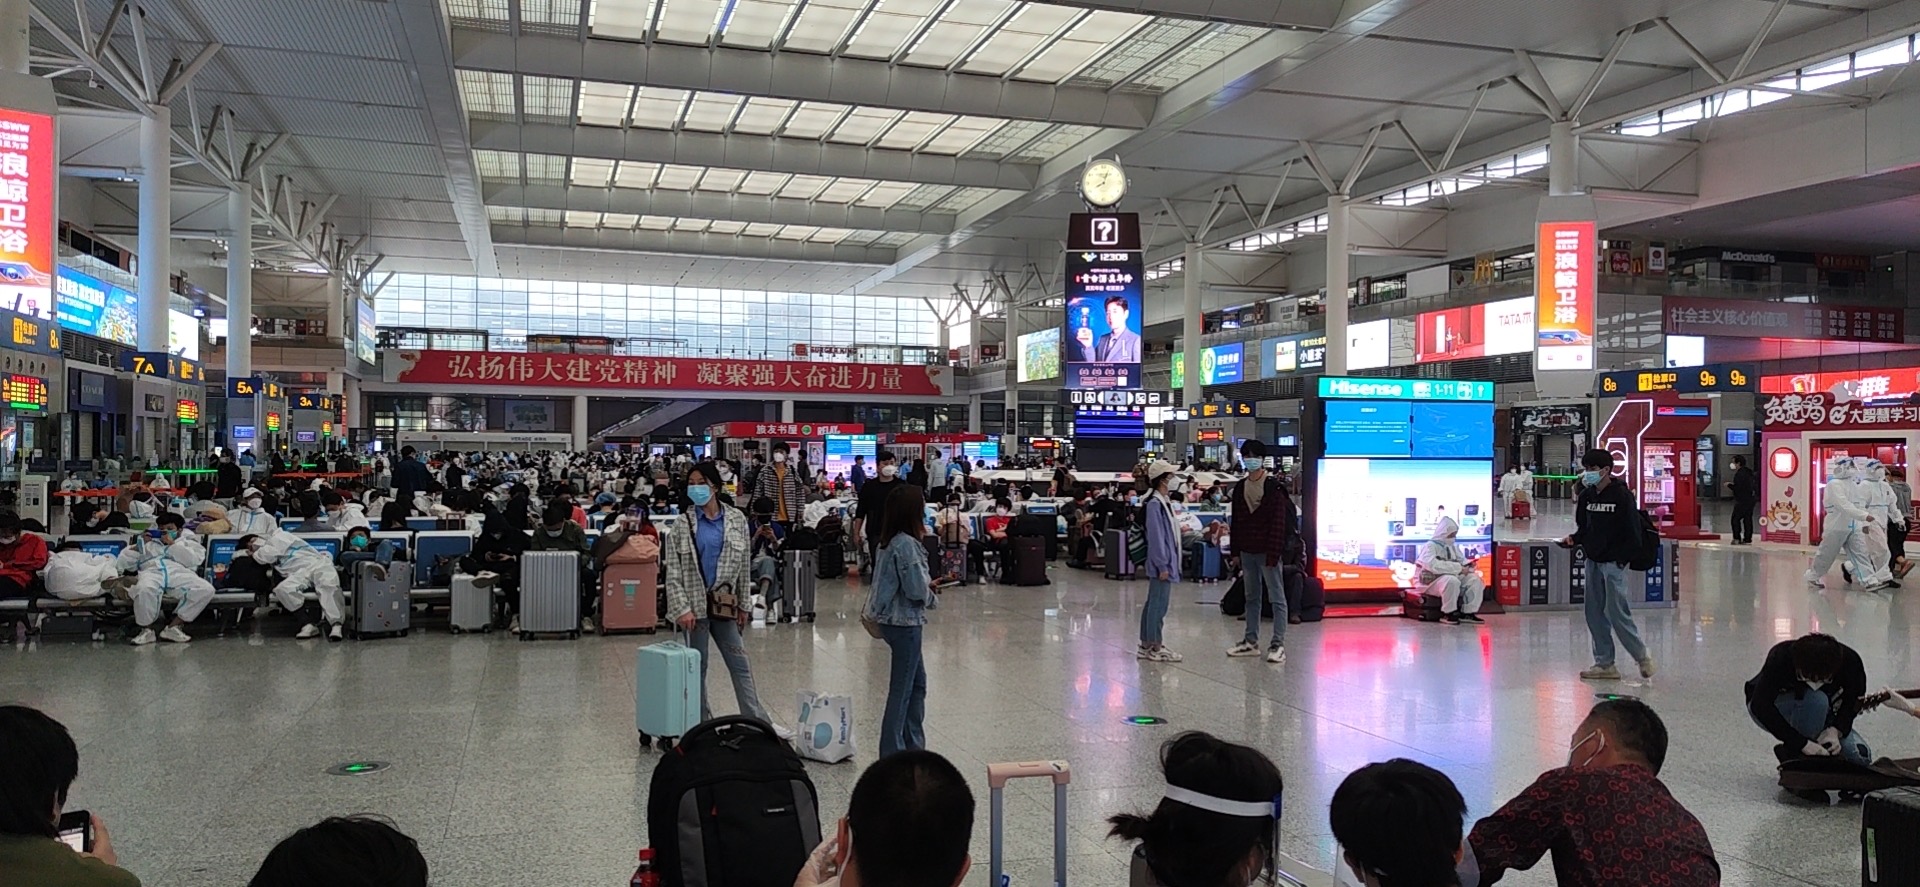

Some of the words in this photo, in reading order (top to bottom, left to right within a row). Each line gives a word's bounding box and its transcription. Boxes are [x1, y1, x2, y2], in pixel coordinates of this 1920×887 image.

[1100, 253, 1129, 261] 12306
[1722, 251, 1775, 263] McDonald's
[1554, 252, 1579, 324] 浪鲸卫浴
[1671, 307, 1788, 328] 社会主义核心价值观
[50, 330, 59, 349] 8A
[133, 357, 154, 373] 7A
[447, 355, 678, 385] 弘扬伟大建党精神
[697, 362, 902, 390] 凝聚强大奋进力量
[1603, 377, 1617, 391] 8B
[1653, 373, 1677, 383] 检票口
[1700, 370, 1716, 386] 9B
[1730, 370, 1746, 385] 9B
[237, 381, 253, 393] 5A
[1329, 379, 1402, 396] Hisense
[1434, 383, 1454, 396] 1-11
[300, 396, 312, 406] 3A
[1849, 406, 1920, 423] 大智慧学习
[756, 424, 798, 435] 旅友书屋
[839, 707, 847, 744] FamilyMart
